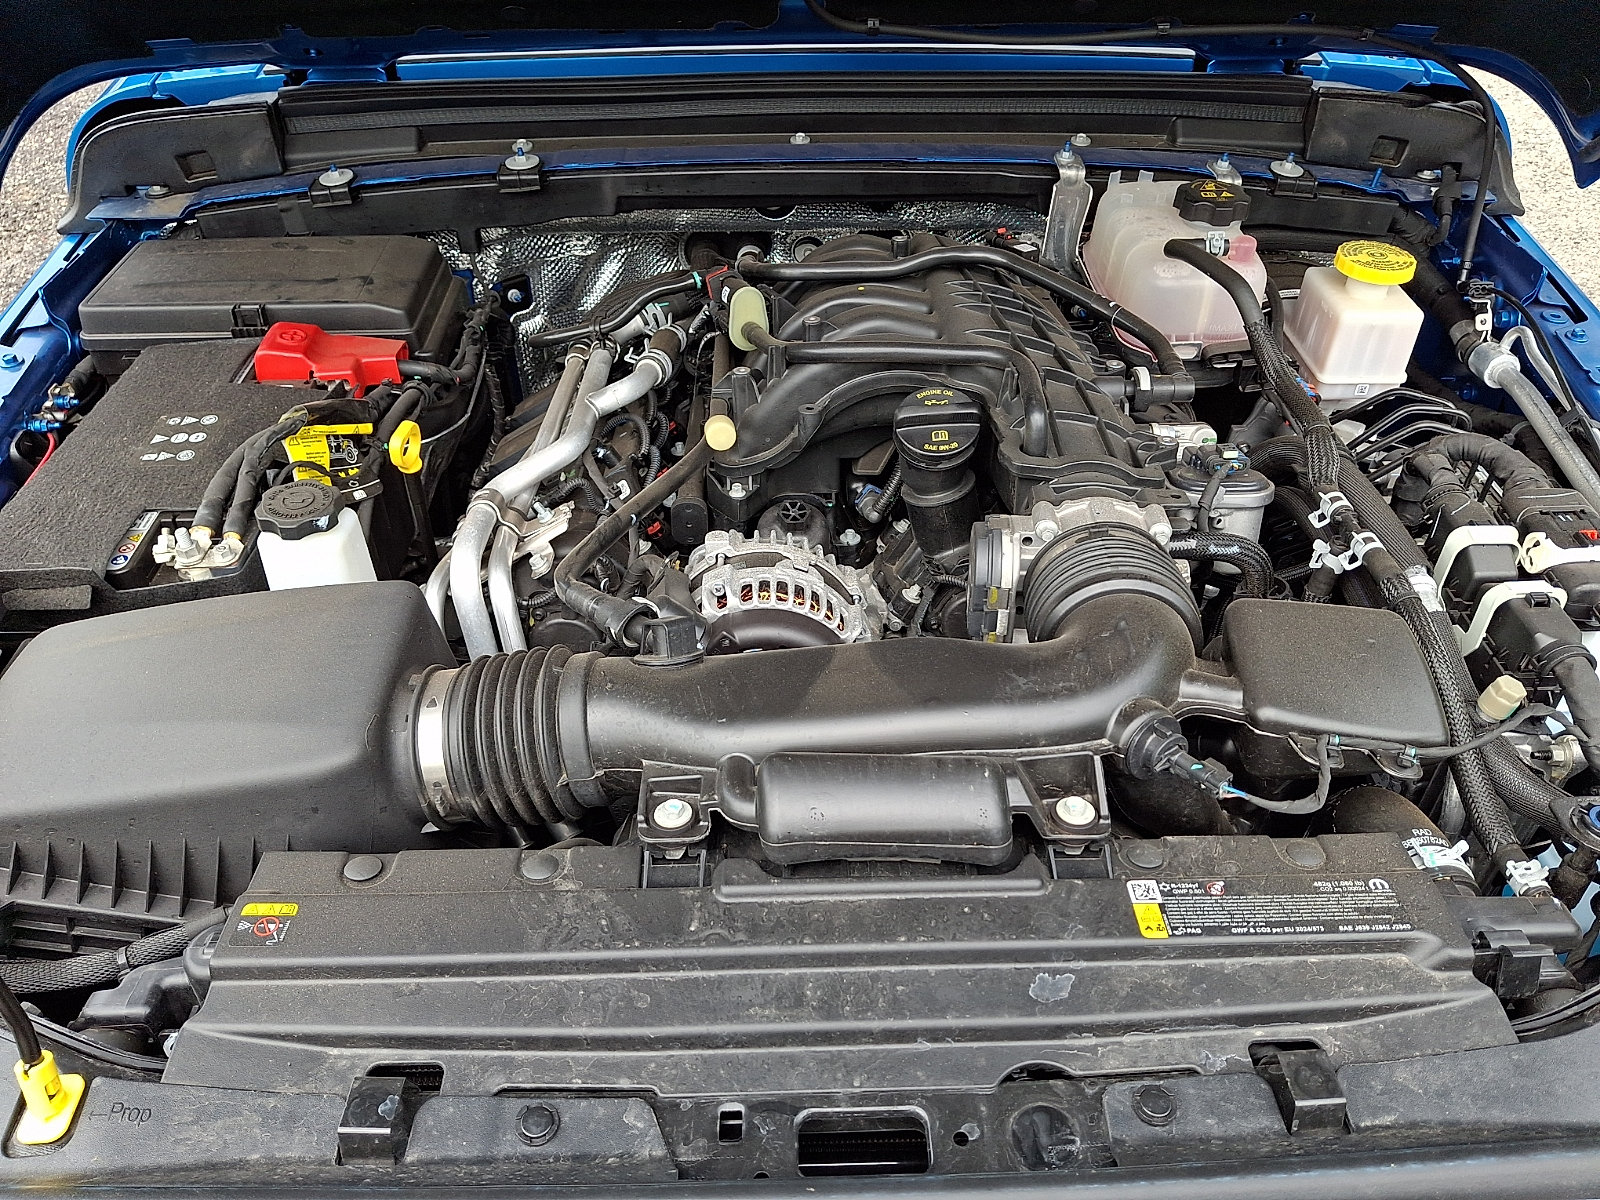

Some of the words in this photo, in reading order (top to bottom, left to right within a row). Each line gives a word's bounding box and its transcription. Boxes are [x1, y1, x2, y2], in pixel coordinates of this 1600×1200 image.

[916, 389, 942, 399] ENGINE
[943, 389, 954, 397] OIL
[924, 443, 938, 451] SAE
[939, 442, 958, 450] 0W-20
[108, 1102, 152, 1127] Prop
